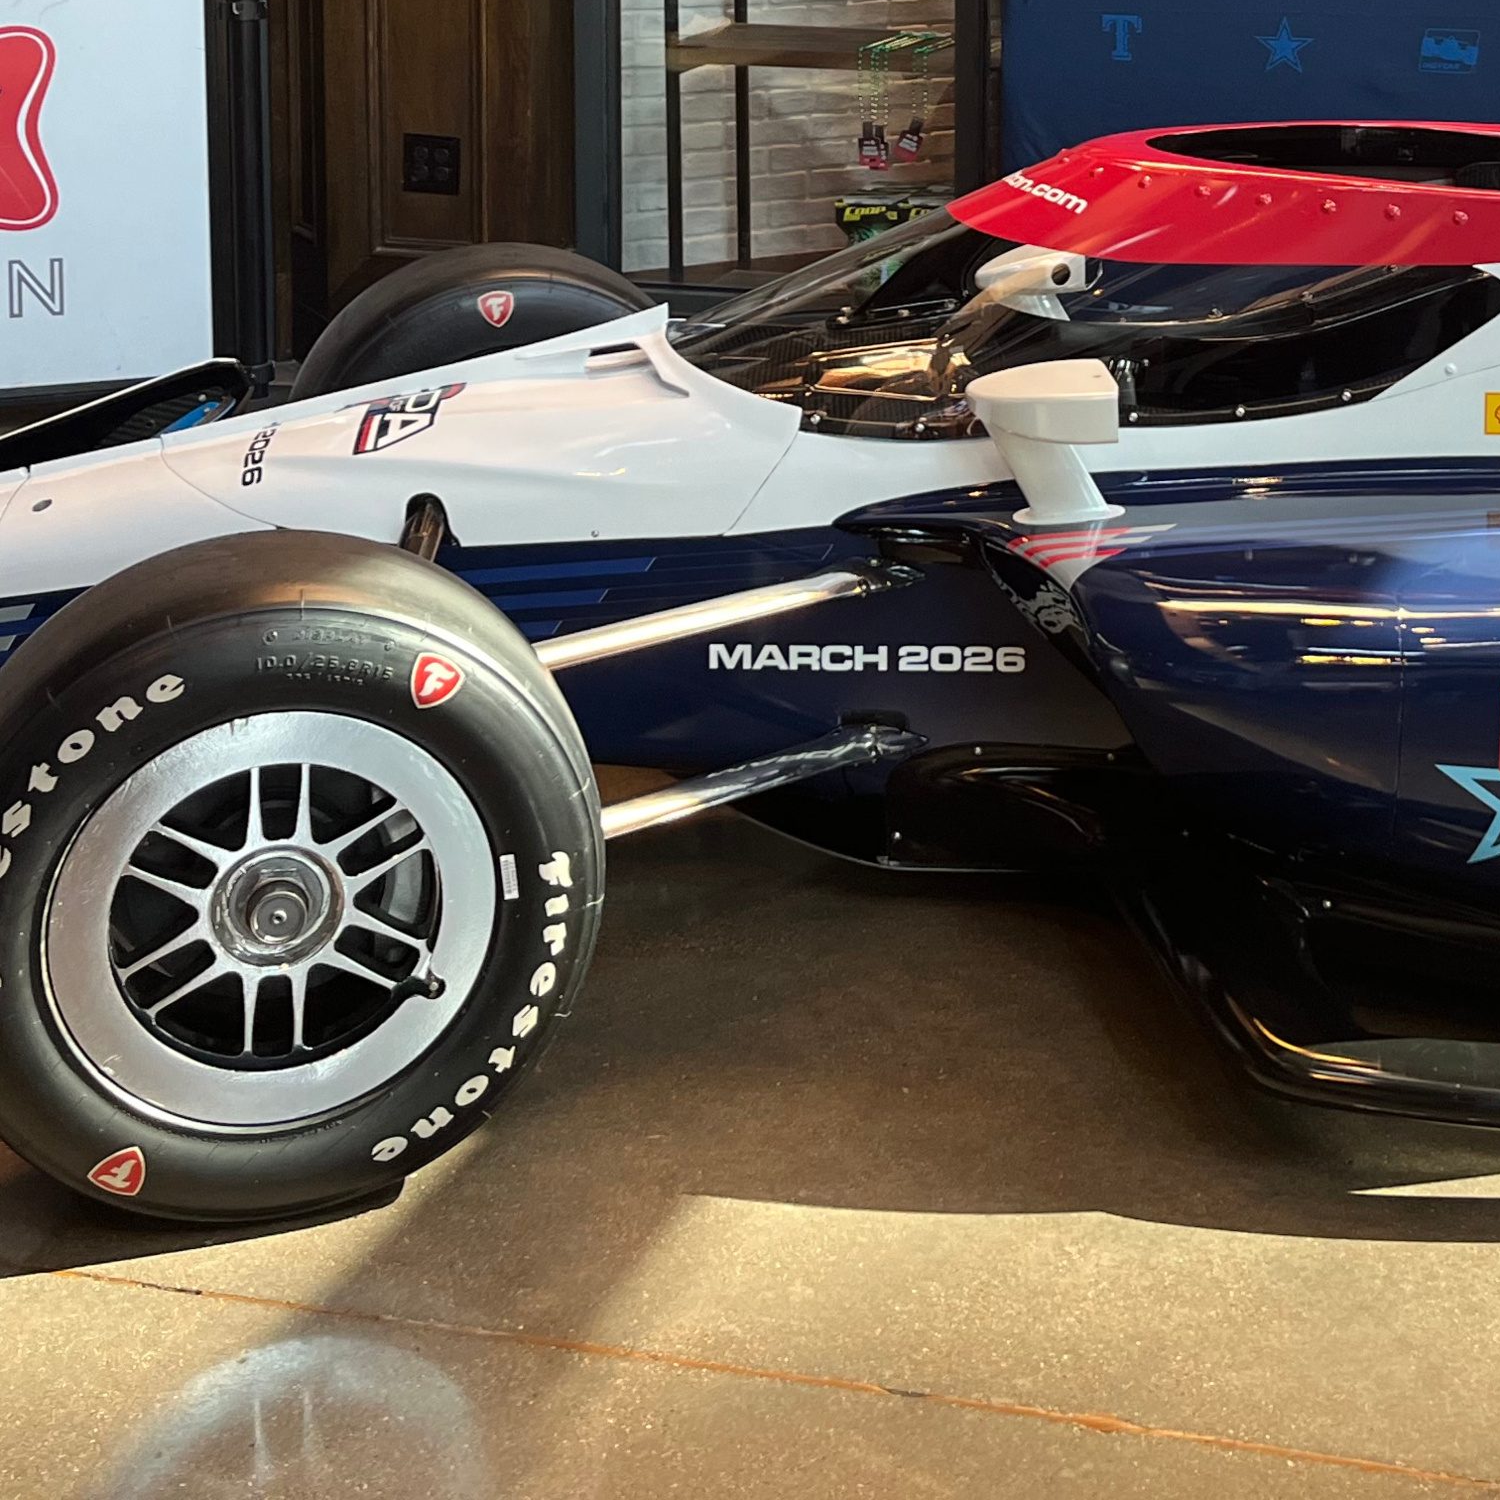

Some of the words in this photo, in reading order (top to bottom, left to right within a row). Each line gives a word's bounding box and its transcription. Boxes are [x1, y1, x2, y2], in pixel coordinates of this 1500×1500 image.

[1101, 14, 1143, 61] T
[242, 428, 277, 486] 2026
[708, 643, 888, 671] MARCH
[898, 645, 1026, 673] 2026
[372, 851, 572, 1162] Firestone
